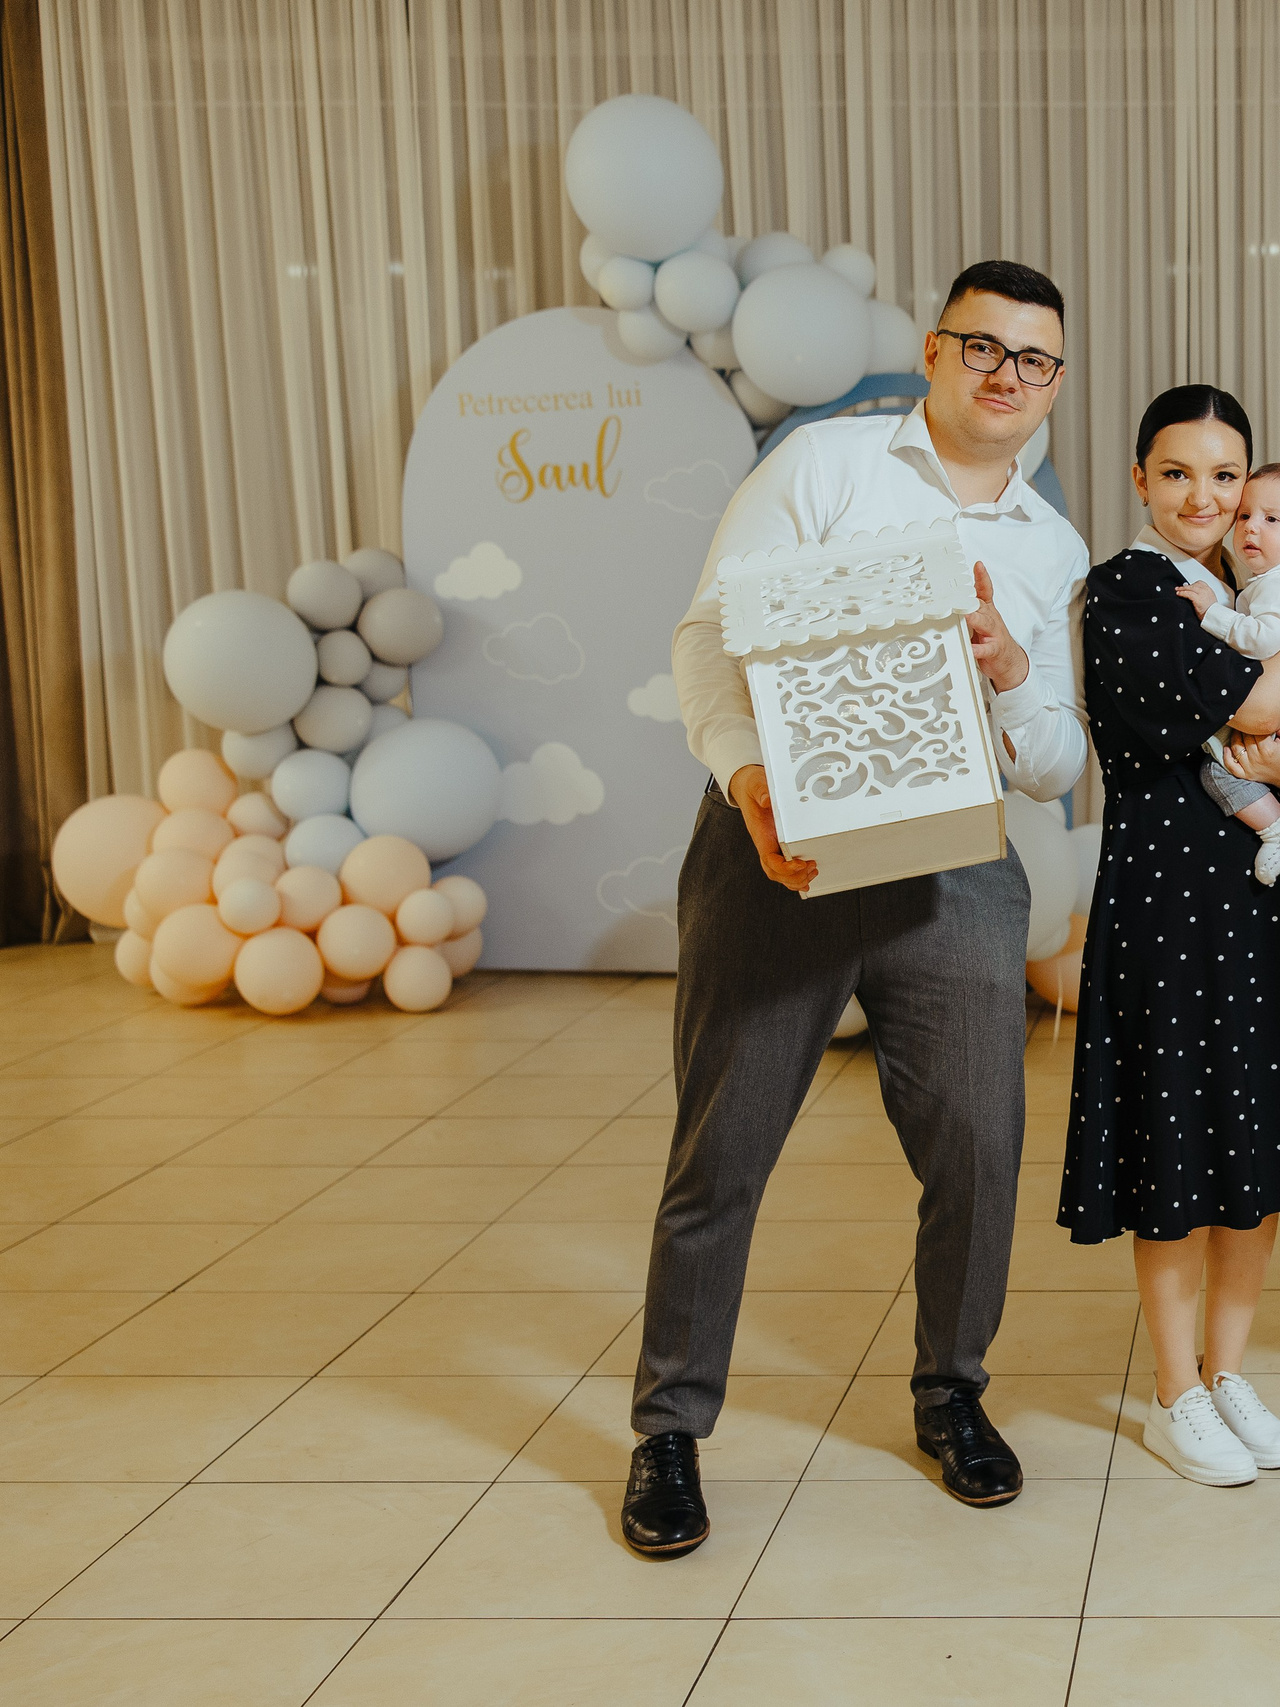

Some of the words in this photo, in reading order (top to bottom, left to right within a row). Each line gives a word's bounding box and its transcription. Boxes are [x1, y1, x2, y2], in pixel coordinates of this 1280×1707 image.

[457, 391, 593, 418] Petrecerea
[607, 381, 643, 409] lui
[495, 414, 623, 504] Saul
